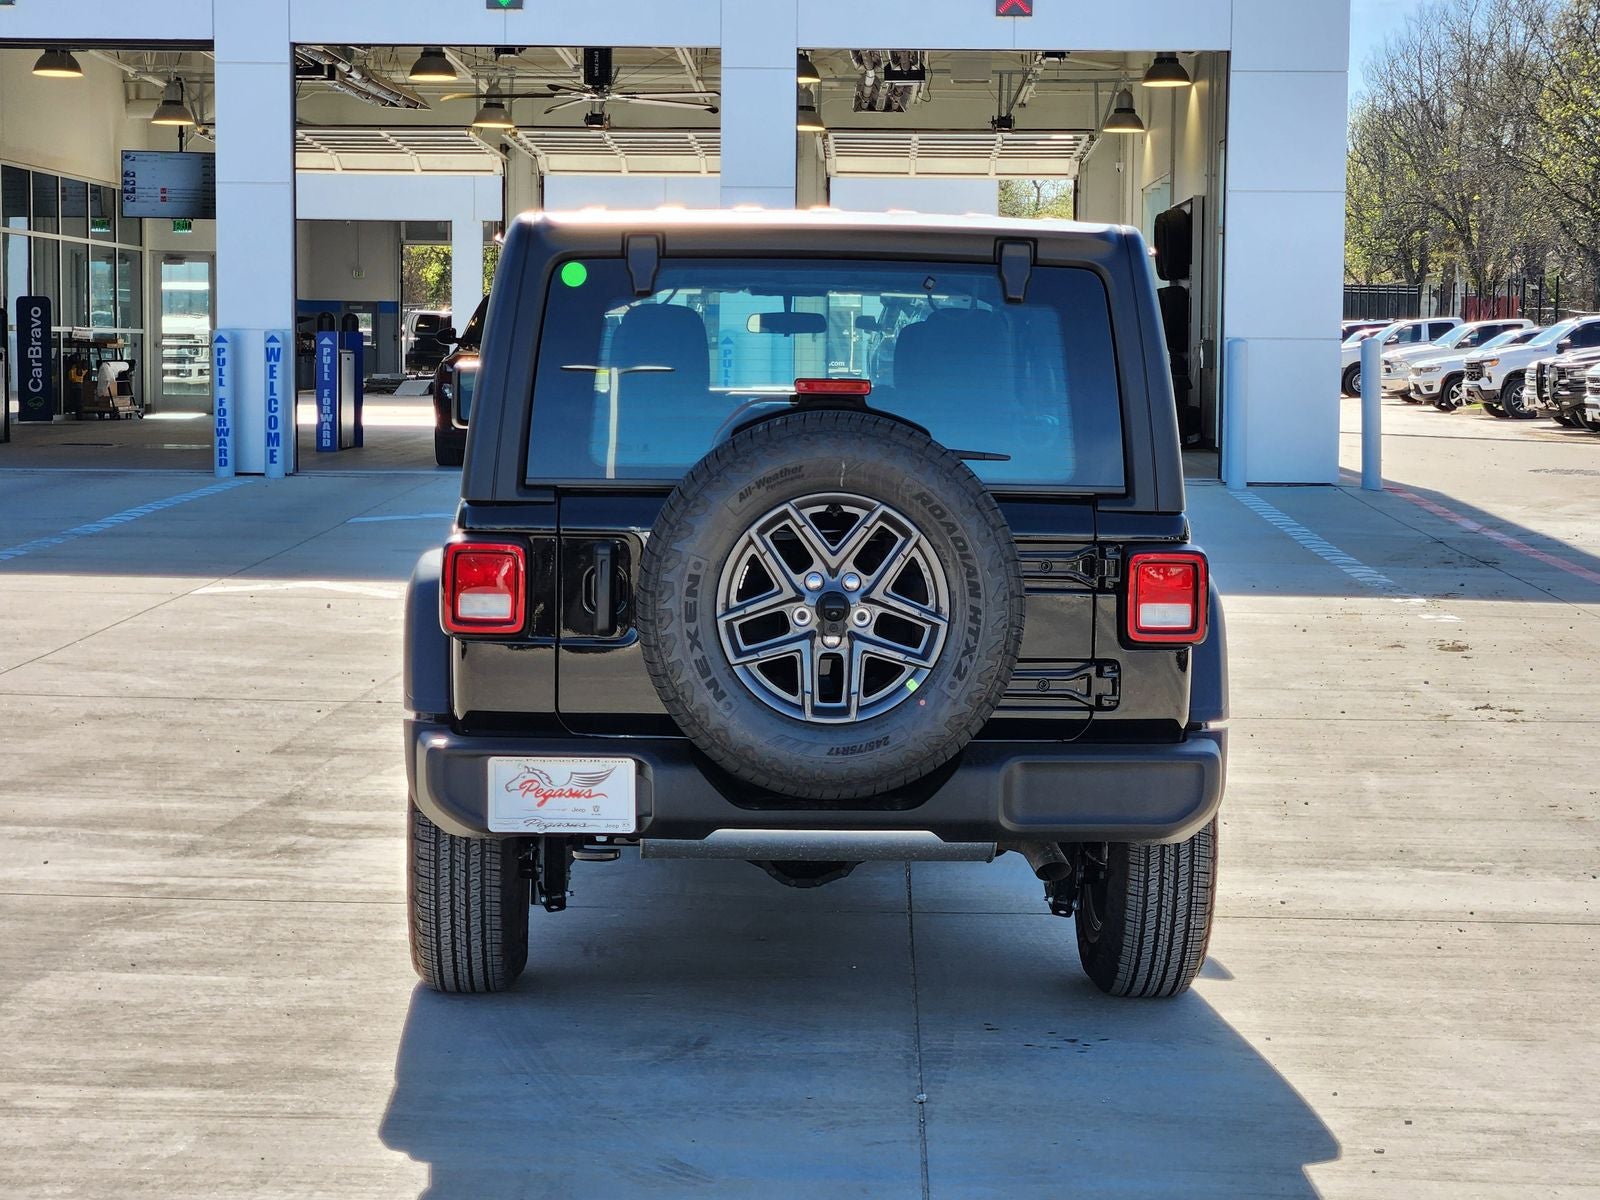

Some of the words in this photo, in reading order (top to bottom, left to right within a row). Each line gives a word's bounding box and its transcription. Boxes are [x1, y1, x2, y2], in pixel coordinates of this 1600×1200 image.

[28, 306, 43, 393] CarBravo
[216, 347, 226, 387] PULL
[322, 348, 331, 381] PULL
[216, 398, 230, 467] FORWARD
[265, 347, 281, 464] WELCOME
[320, 389, 333, 447] FORWARD
[738, 465, 804, 503] All-Weather
[911, 491, 982, 598] ROADIAN
[684, 573, 727, 702] NEXEN
[519, 779, 608, 808] Pegasus
[523, 818, 601, 831] Pegasus
